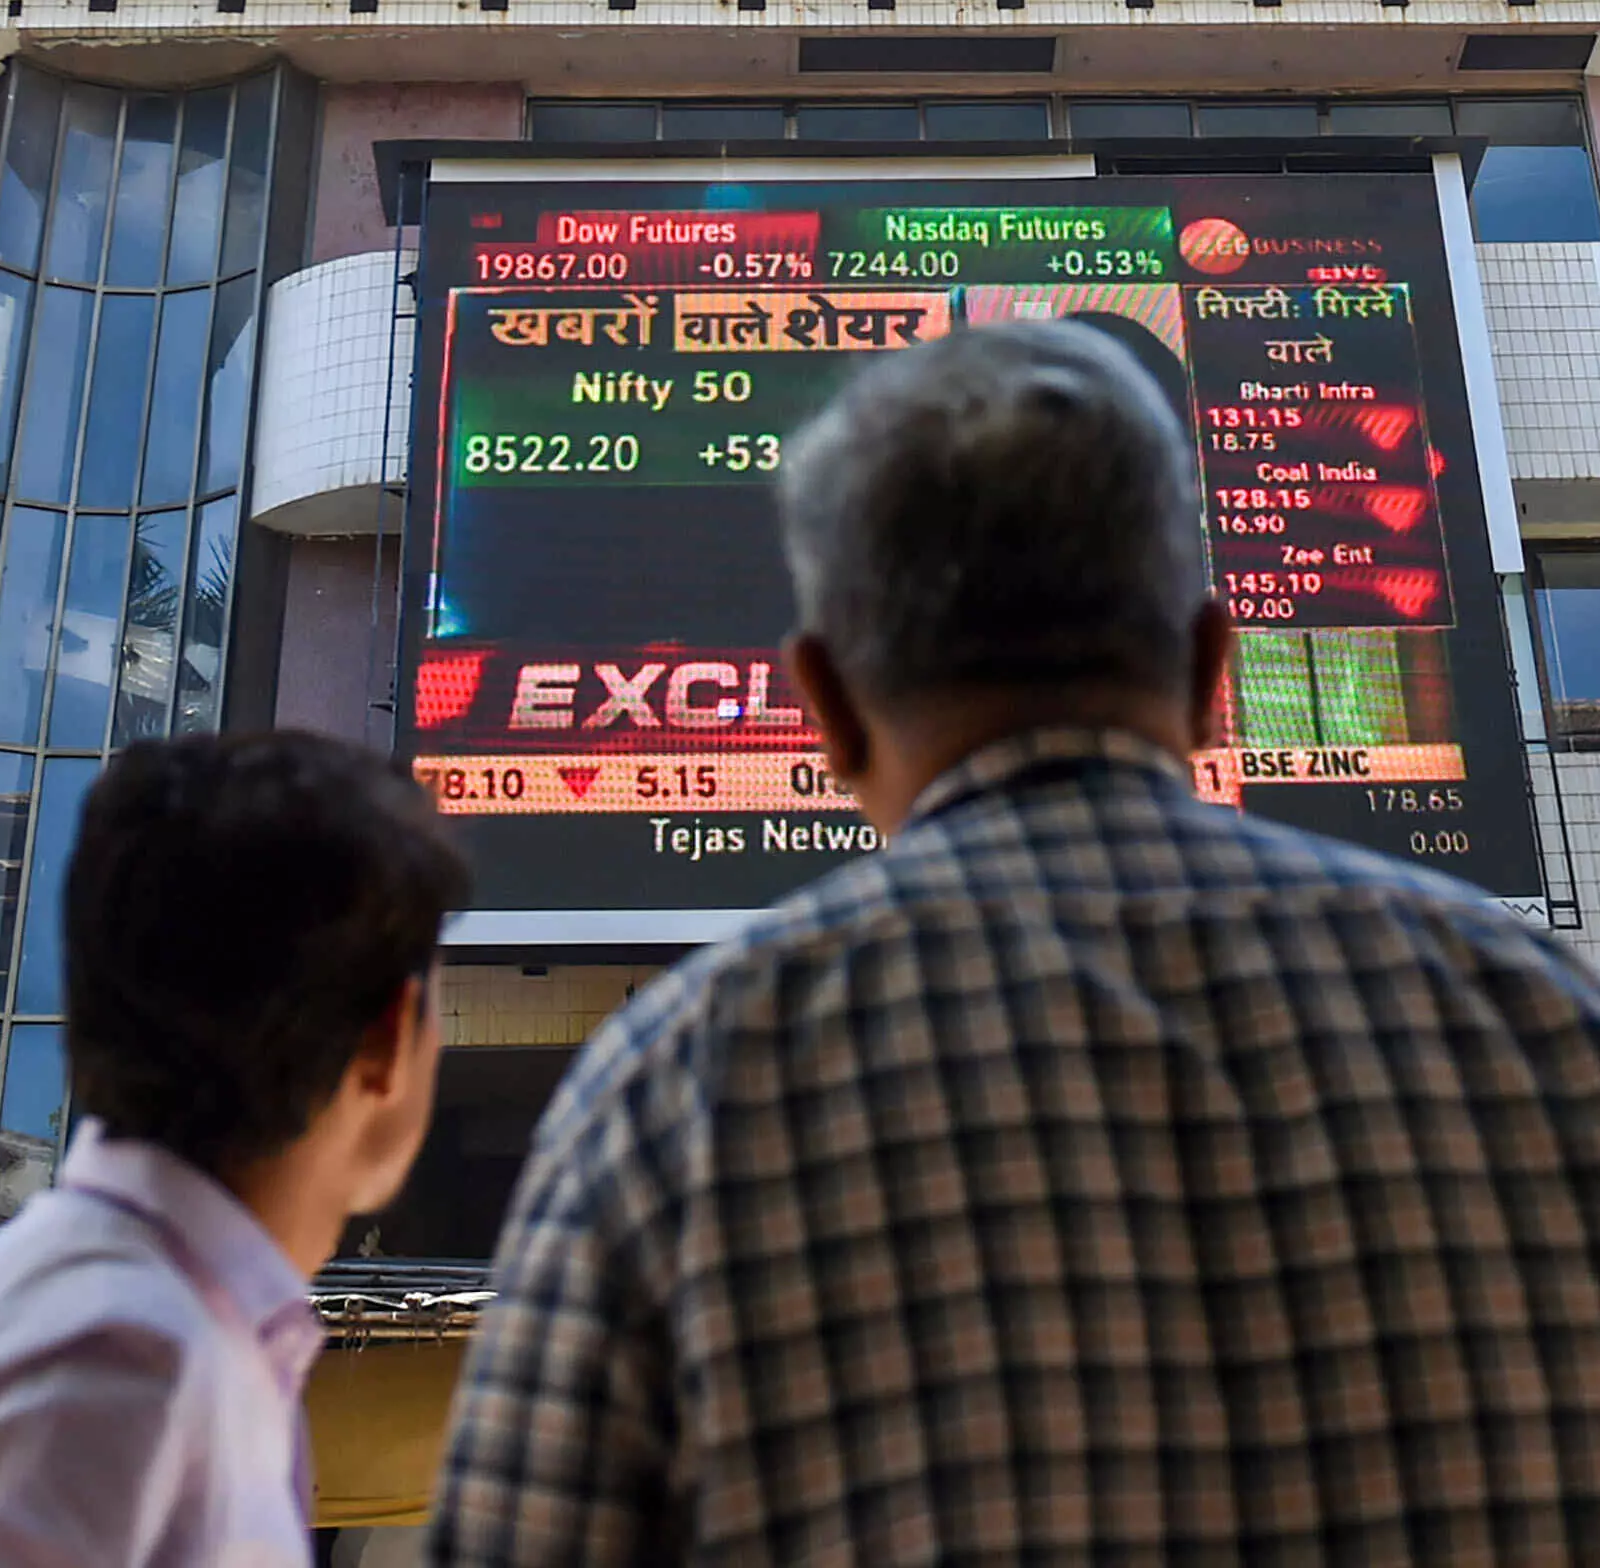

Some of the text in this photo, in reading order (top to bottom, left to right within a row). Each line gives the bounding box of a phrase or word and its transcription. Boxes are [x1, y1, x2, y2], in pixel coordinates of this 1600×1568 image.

[557, 216, 737, 243] Dow Futures
[886, 214, 1106, 247] Nasdaq Futures
[476, 252, 813, 279] 19867.00 -0.57%
[828, 249, 1163, 277] 7244.00 +0.53%
[487, 293, 927, 348] खबरों वाले शेयर
[1264, 332, 1334, 364] वाले
[573, 370, 752, 411] Nifty 50
[1240, 382, 1376, 400] Bharti Infra
[1207, 408, 1303, 428] 131.15
[464, 436, 640, 472] 8522.20
[1210, 433, 1277, 451] 18.75
[1257, 462, 1378, 482] Coal India
[1216, 489, 1312, 509] 128.15
[1218, 514, 1286, 533] 16.90
[1281, 544, 1373, 566] Zee Ent
[1225, 573, 1322, 594] 145.10
[1228, 599, 1295, 620] 19.00
[508, 662, 803, 730] EXCL
[1242, 750, 1370, 778] BSE ZINC
[636, 765, 717, 798] 5.15
[1365, 790, 1464, 811] 178.65
[651, 818, 746, 860] Tejas
[1409, 832, 1469, 854] 0.00
